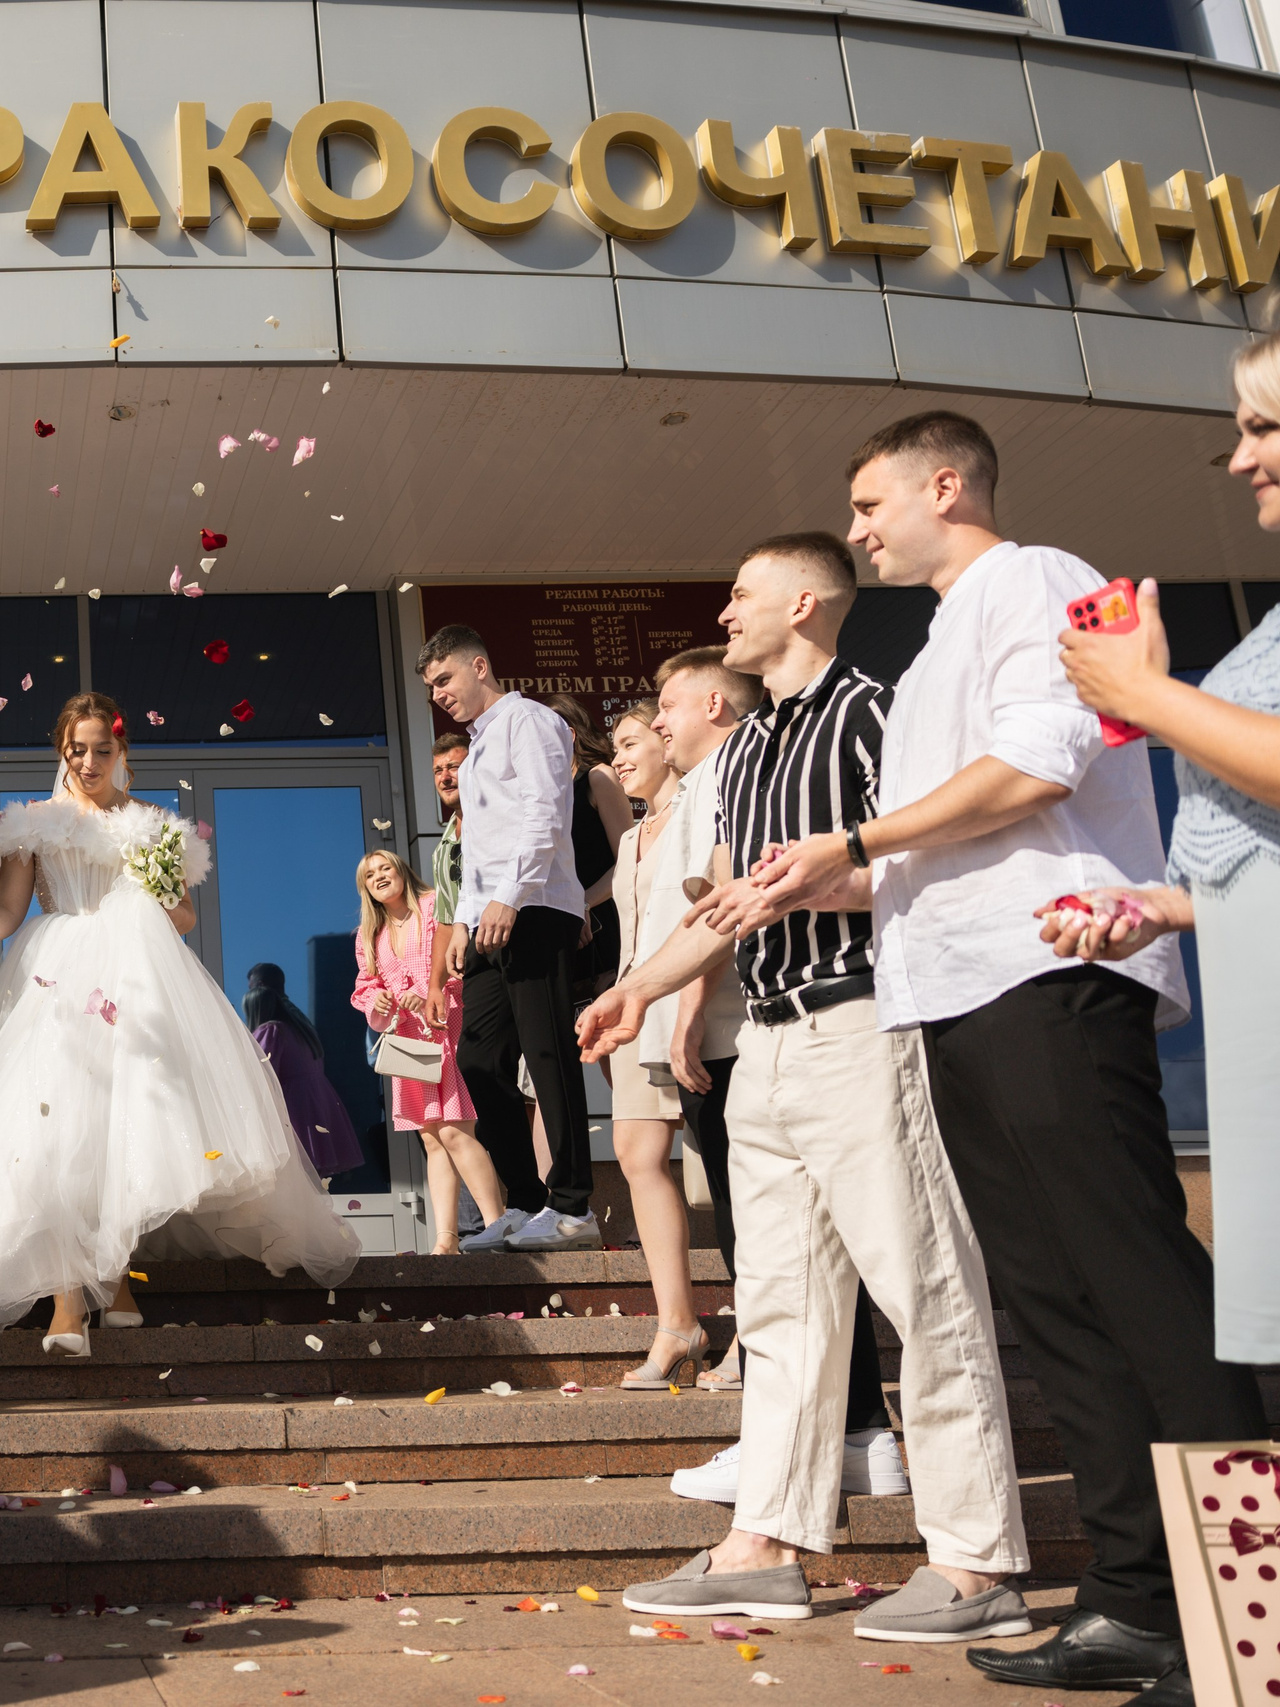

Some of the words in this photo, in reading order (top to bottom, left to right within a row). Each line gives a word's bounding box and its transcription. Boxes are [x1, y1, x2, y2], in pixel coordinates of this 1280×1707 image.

[545, 589, 599, 599] РЕЖИМ
[602, 588, 665, 599] РАБОТЫ:
[562, 602, 616, 612] РАБОЧИЙ
[619, 603, 652, 613] ДЕНЬ:
[648, 630, 693, 638] ПЕРЕРЫВ
[535, 649, 580, 657] ПЯТНИЦА
[536, 660, 578, 668] СУББОТА
[497, 672, 595, 693] ПРИЁМ
